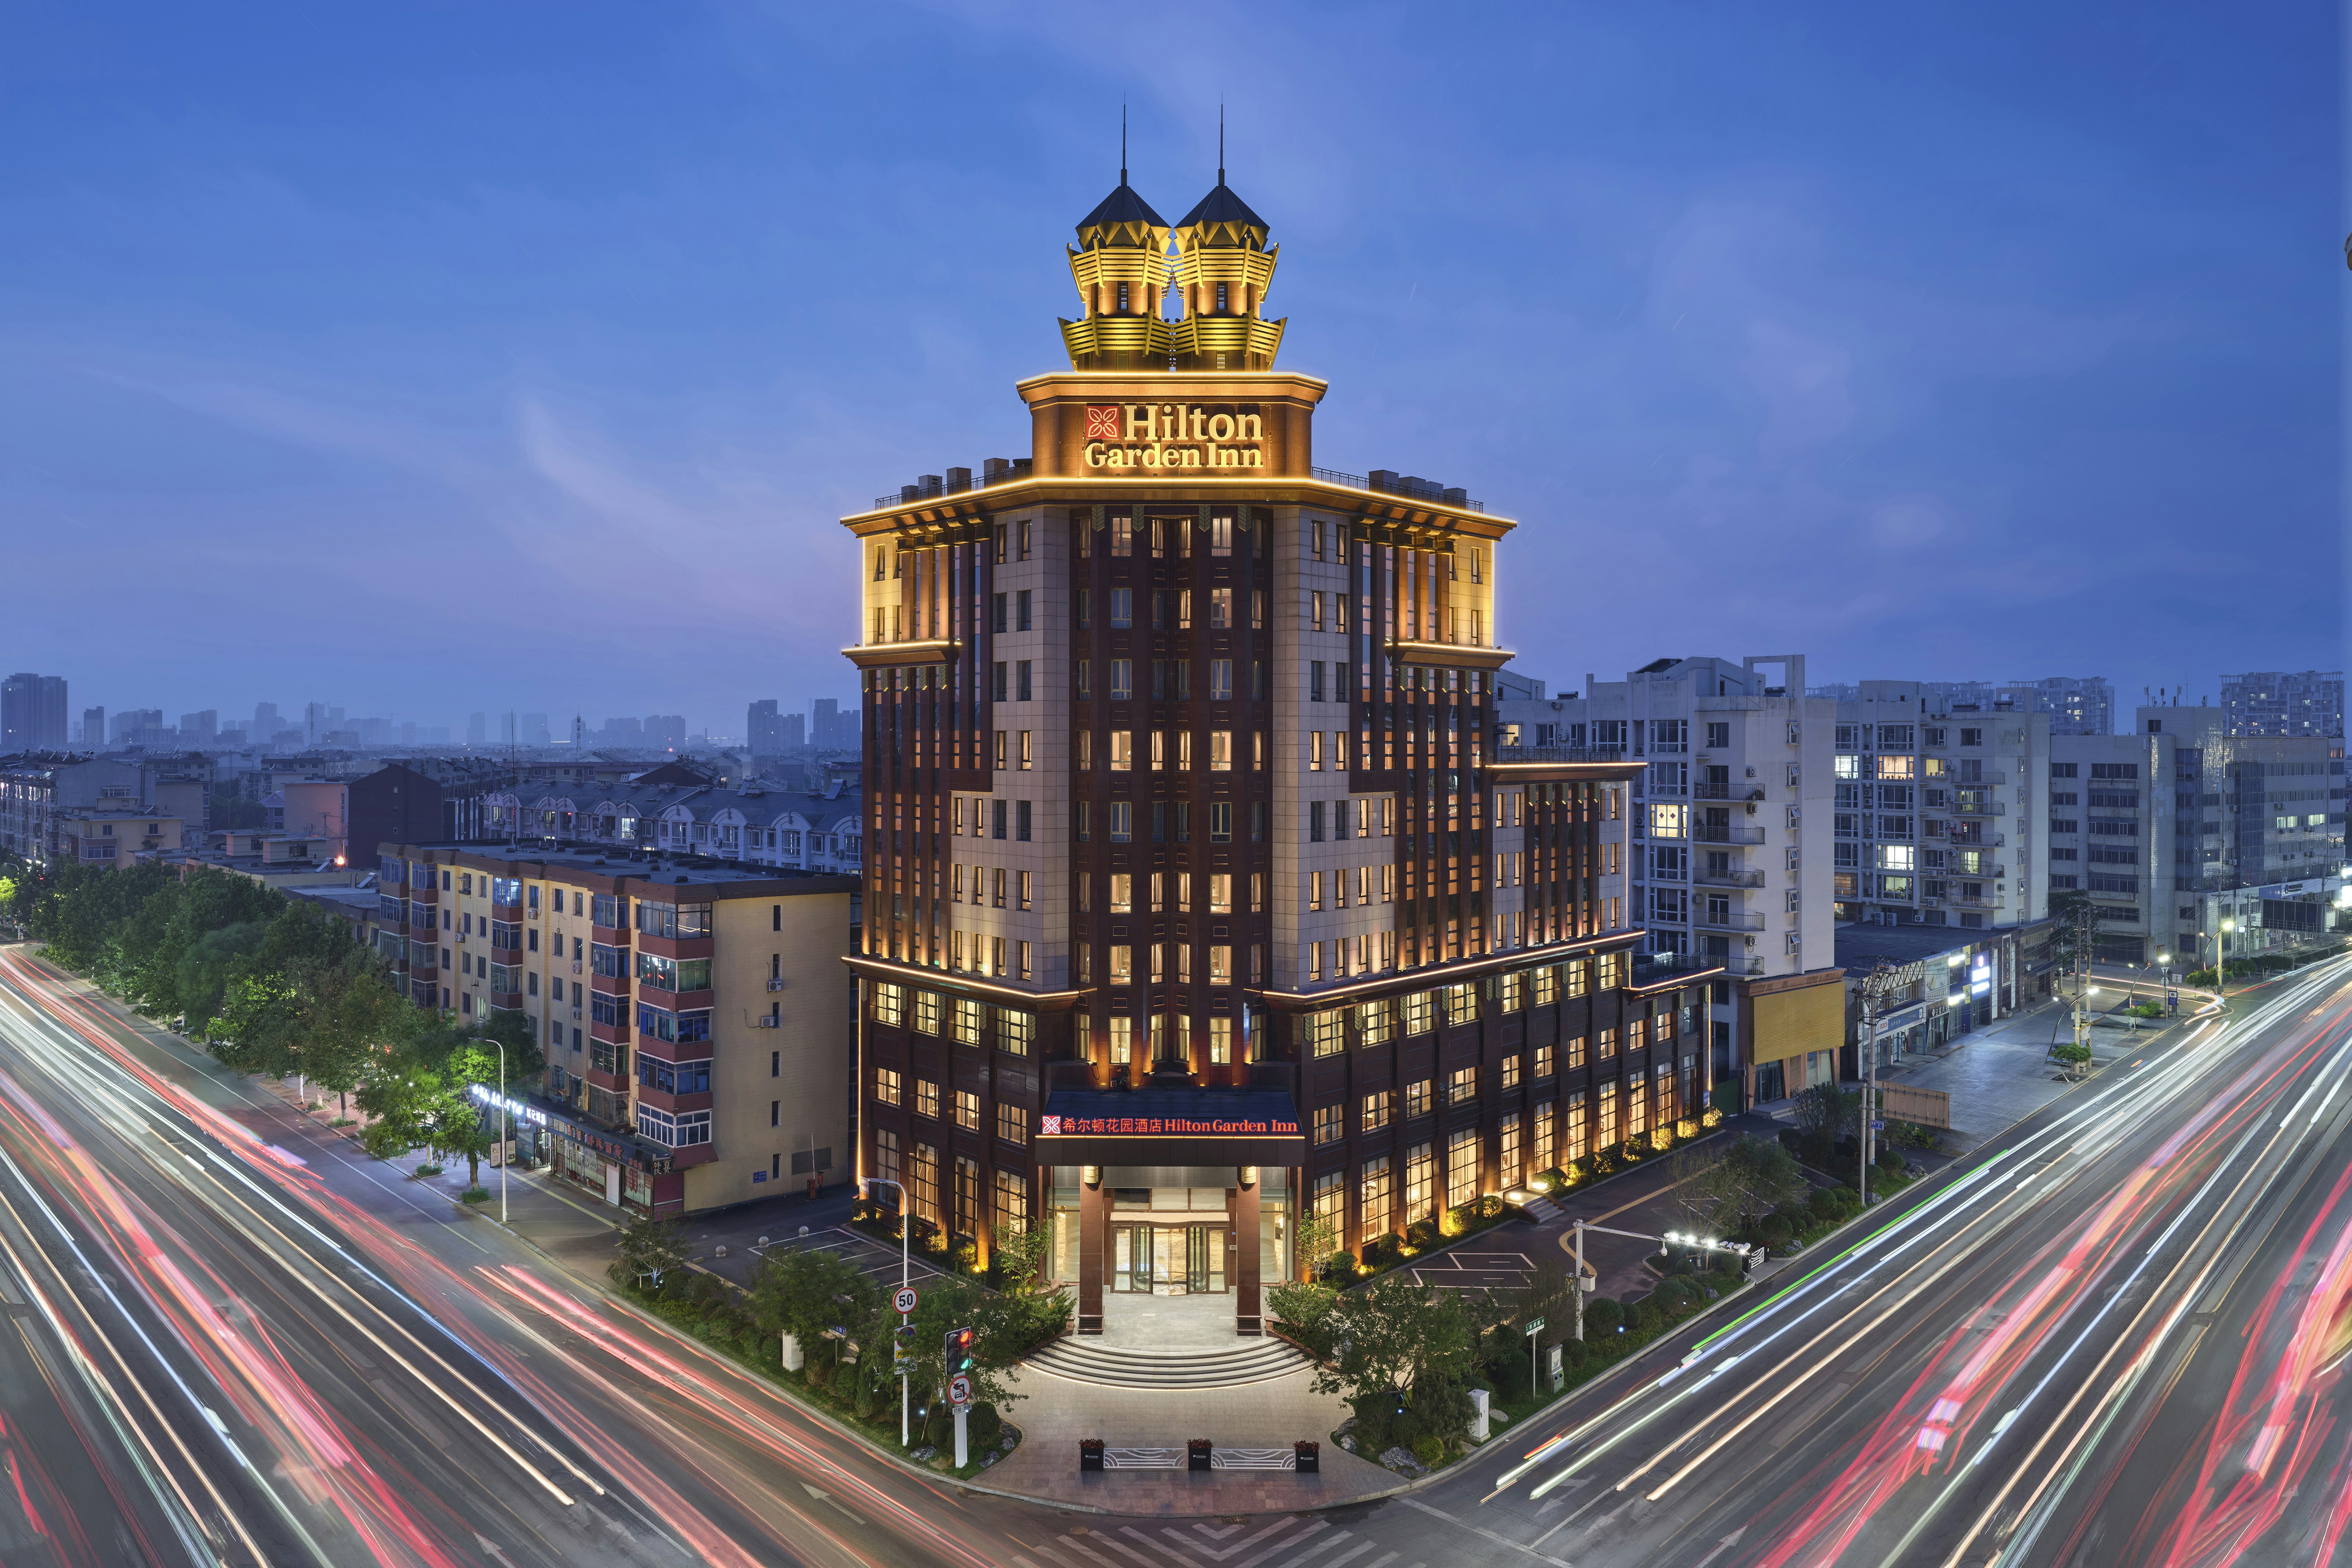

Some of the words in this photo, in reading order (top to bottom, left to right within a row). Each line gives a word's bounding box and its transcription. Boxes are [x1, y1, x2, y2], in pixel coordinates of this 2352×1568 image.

[1124, 405, 1263, 440] Hilton
[1085, 443, 1202, 468] Garden
[1206, 443, 1263, 468] Inn
[1063, 1118, 1161, 1133] 希尔顿花园酒店
[1165, 1119, 1210, 1132] Hilton
[1212, 1119, 1266, 1132] Garden
[1271, 1119, 1298, 1132] Inn
[899, 1293, 913, 1307] 50
[1529, 1320, 1540, 1330] 市府路
